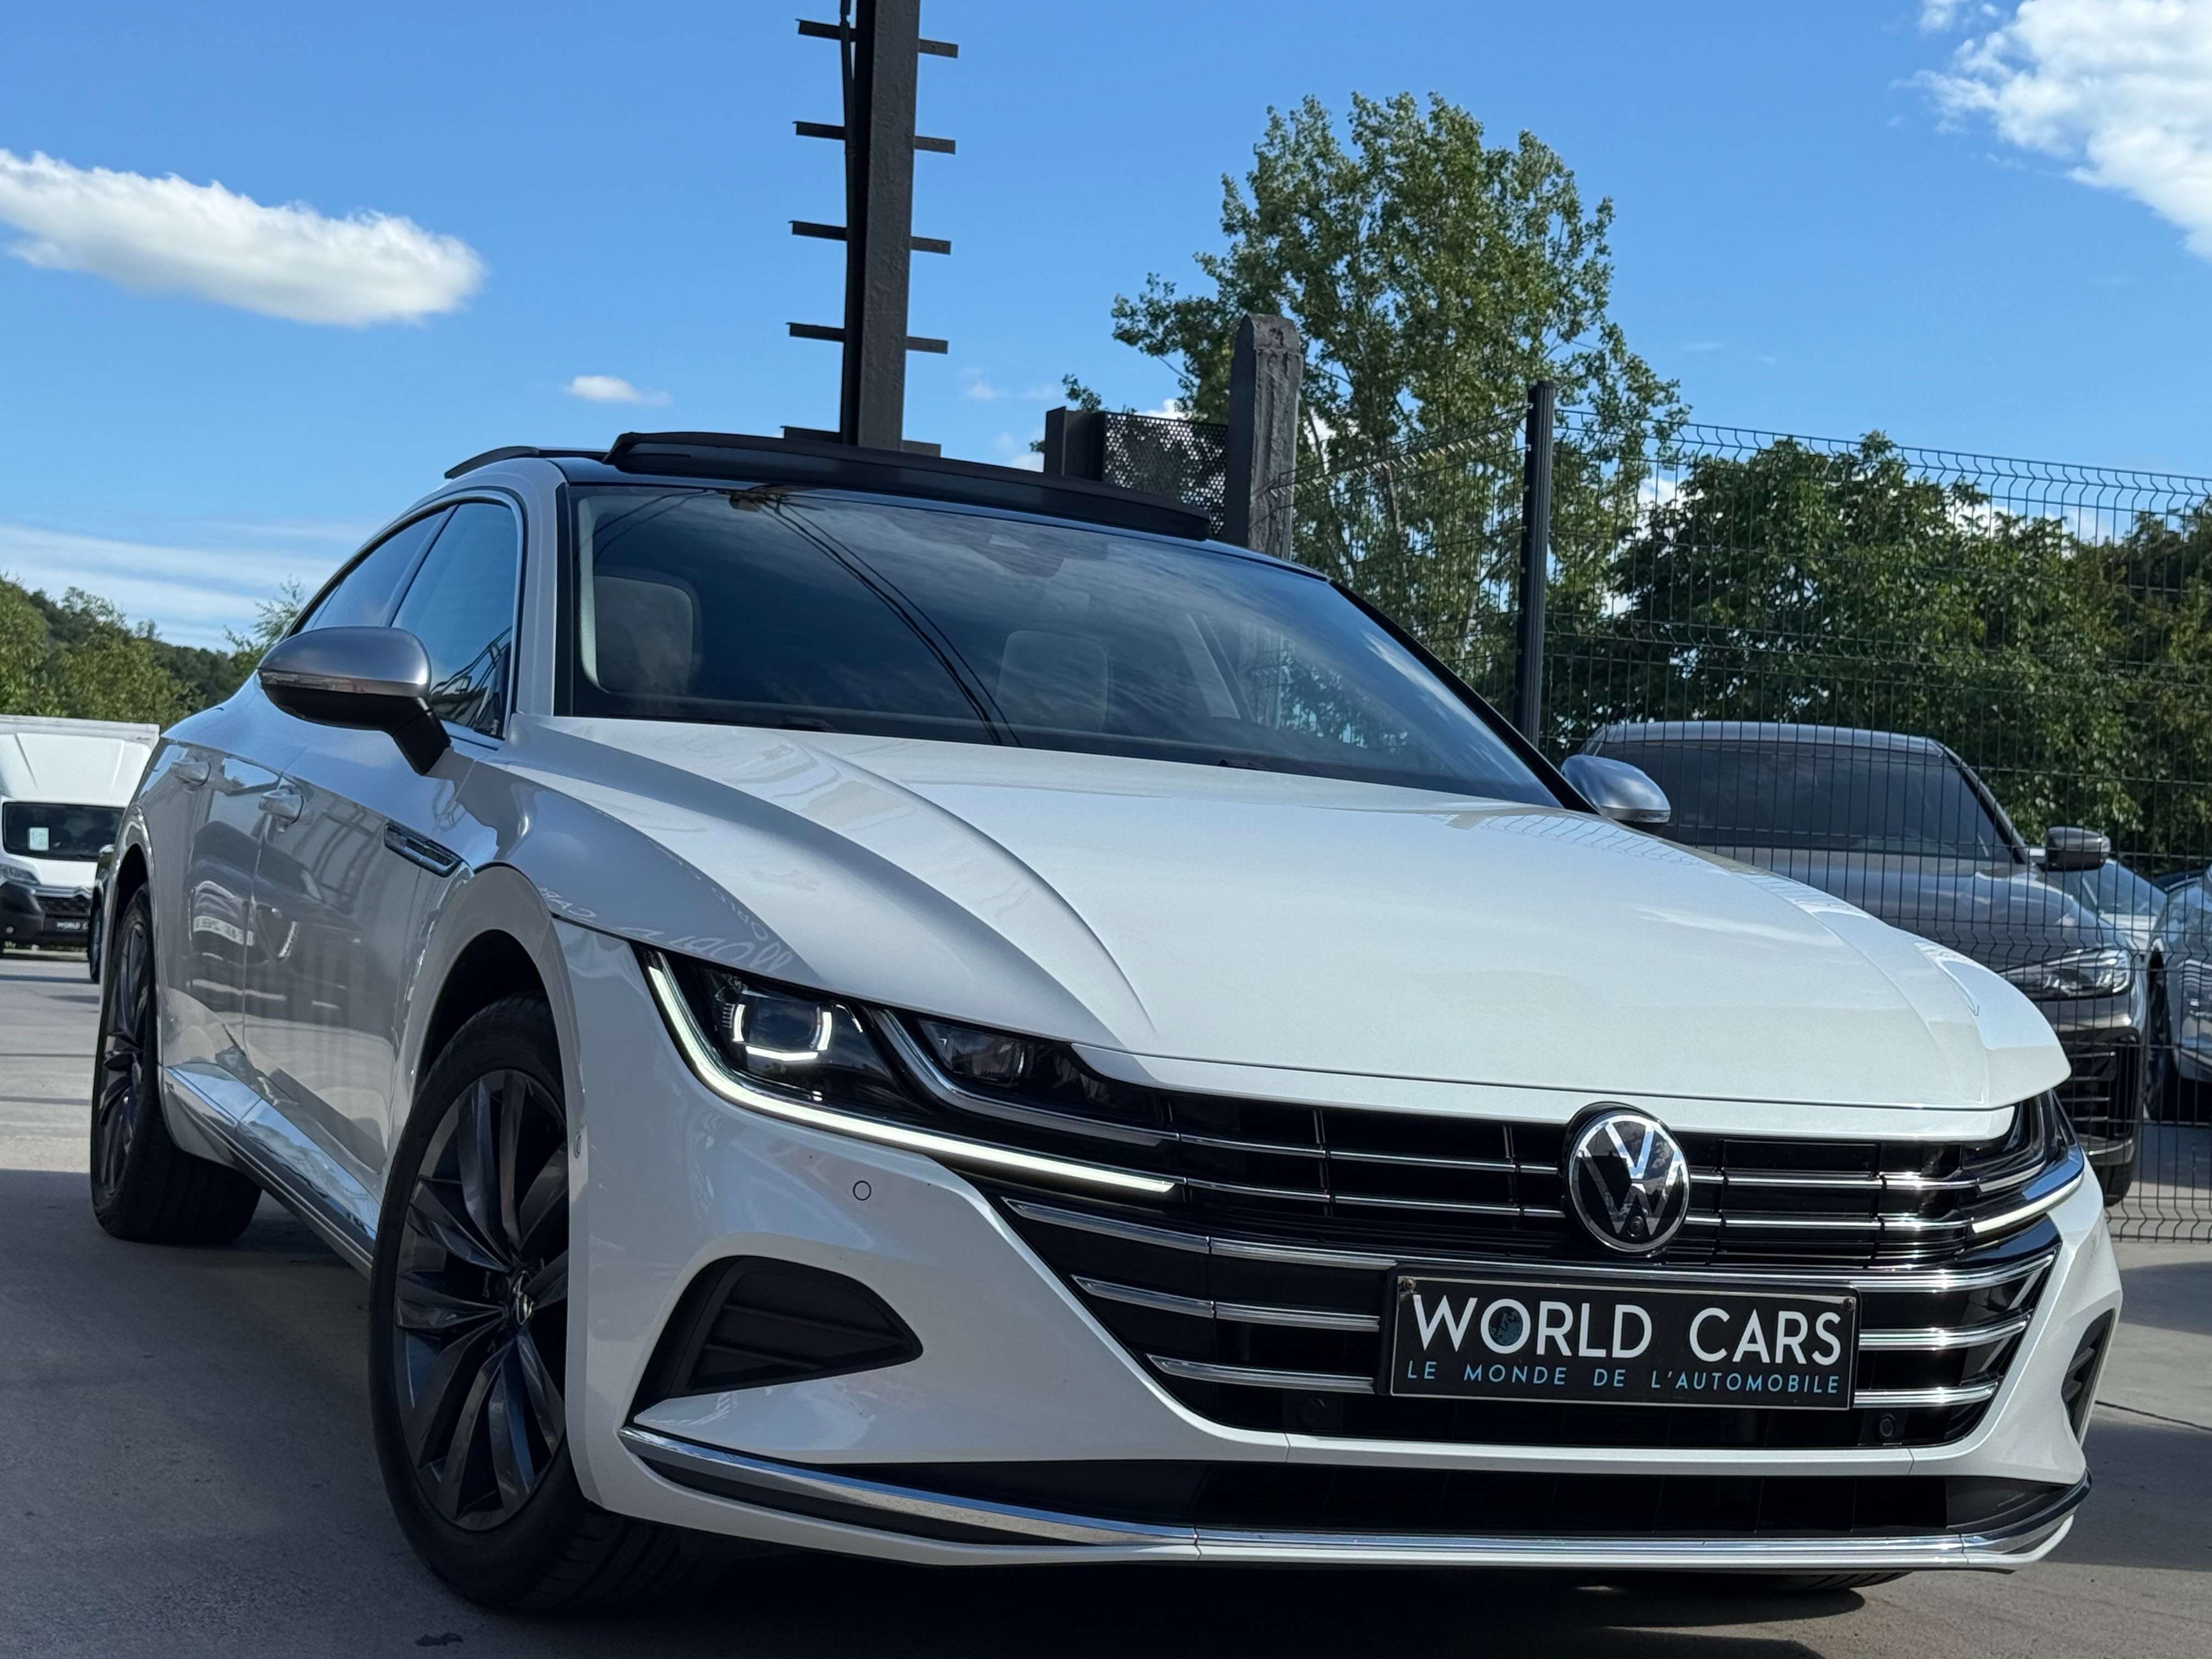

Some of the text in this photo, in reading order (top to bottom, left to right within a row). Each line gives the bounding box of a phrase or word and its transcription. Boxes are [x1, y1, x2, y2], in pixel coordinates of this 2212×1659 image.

[1575, 1119, 1684, 1237] VW
[1413, 1295, 1840, 1365] WORLD CARS
[1408, 1361, 1839, 1393] LE MONDE DE L'AUTOMOBILE
